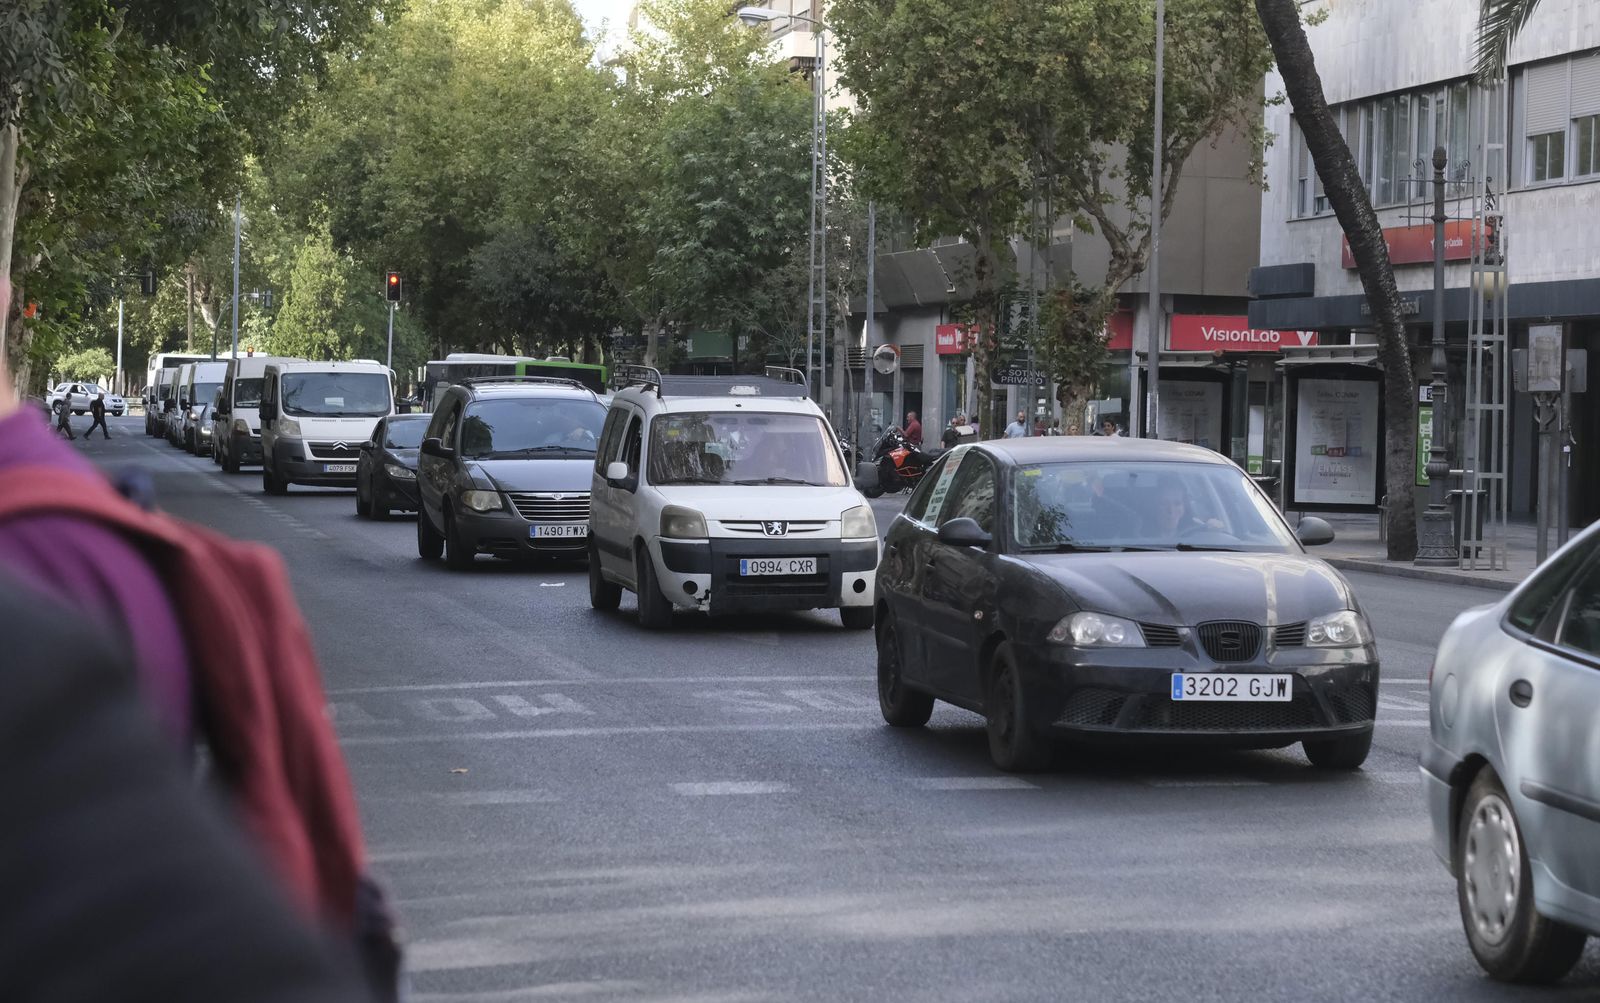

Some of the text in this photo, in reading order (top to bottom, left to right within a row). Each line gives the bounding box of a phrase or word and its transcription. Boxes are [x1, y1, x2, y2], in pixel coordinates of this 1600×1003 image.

[1201, 327, 1281, 342] VisionLab
[1421, 439, 1431, 480] BUS
[539, 526, 585, 536] 1490 FWX
[751, 560, 813, 573] 0994 CXR
[1185, 677, 1287, 697] 3202 GJW
